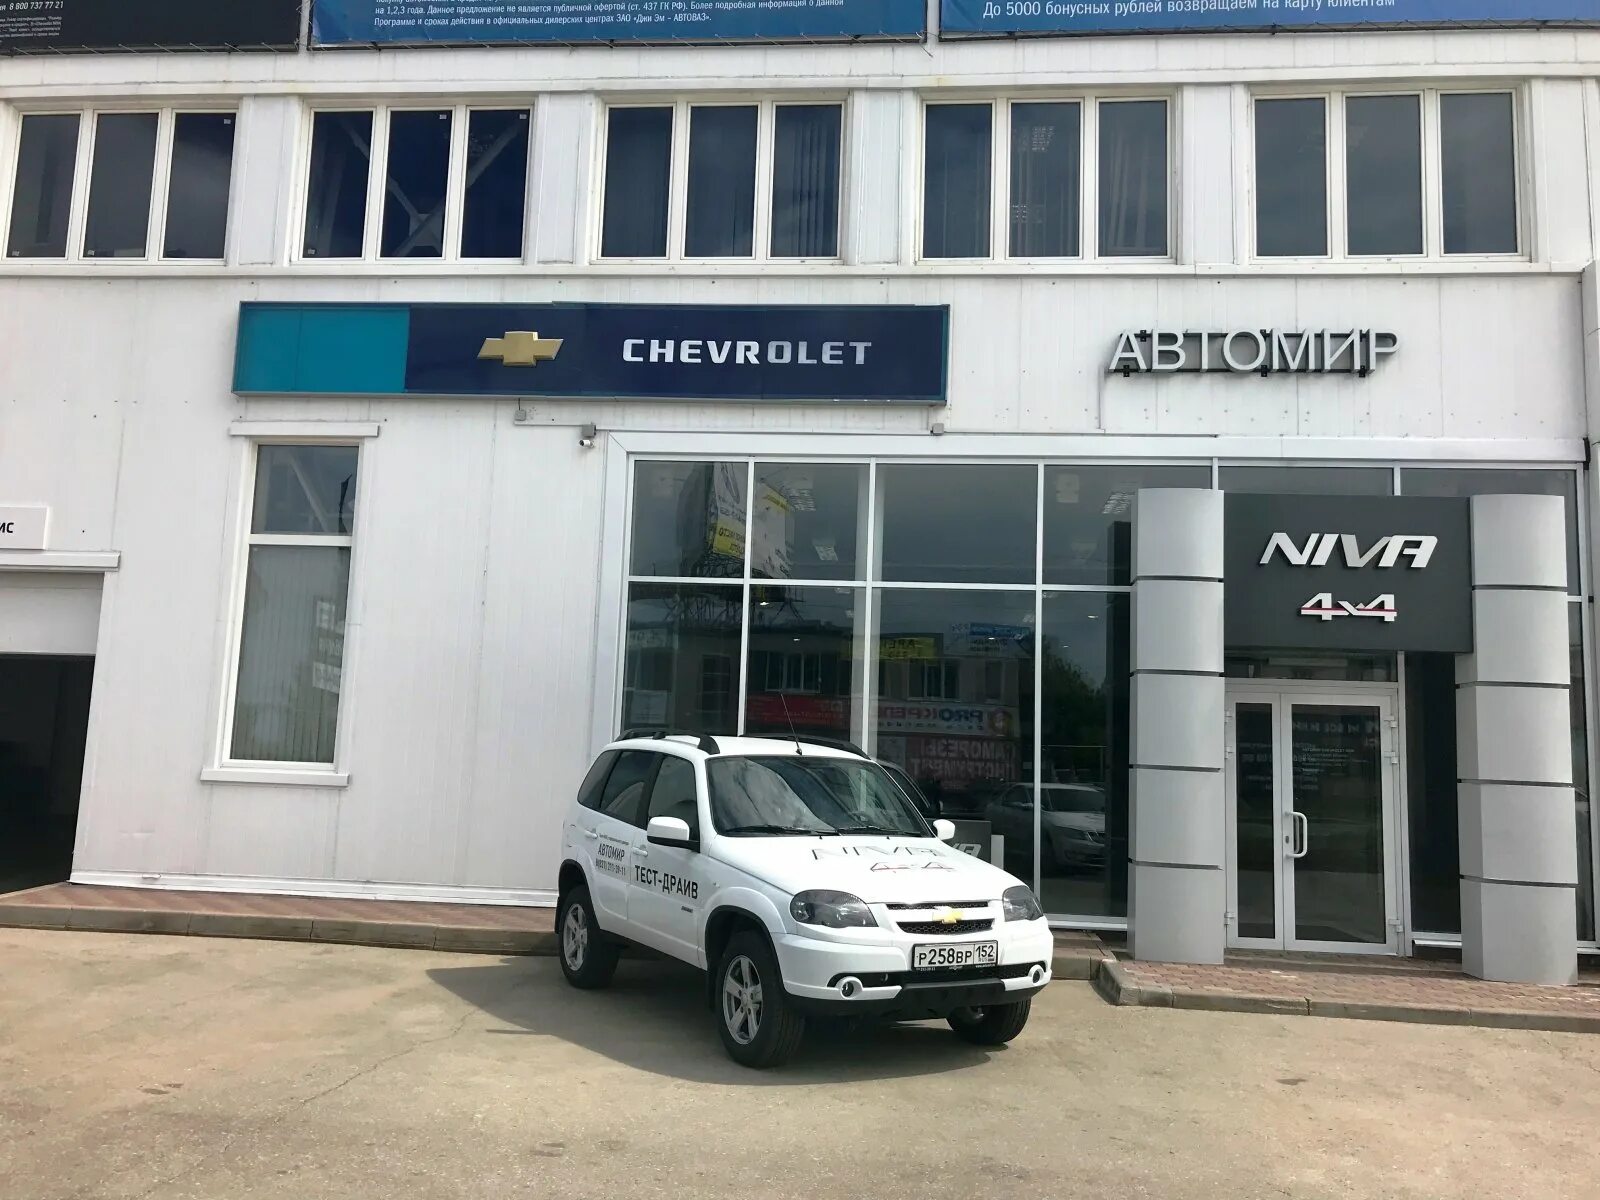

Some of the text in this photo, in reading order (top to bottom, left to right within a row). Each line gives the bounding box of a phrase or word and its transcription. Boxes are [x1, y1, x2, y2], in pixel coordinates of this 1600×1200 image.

[9, 2, 15, 11] 8
[15, 2, 29, 11] 800
[30, 1, 44, 10] 737
[45, 1, 54, 9] 77
[55, 1, 64, 9] 21
[387, 5, 405, 15] 1,2,3
[407, 7, 426, 15] года.
[427, 5, 455, 14] Данное
[456, 5, 505, 14] предложение
[506, 5, 516, 13] не
[517, 5, 551, 13] является
[553, 4, 592, 13] публичной
[593, 2, 626, 13] офертой
[627, 2, 641, 12] (ст.
[643, 2, 657, 11] 437
[660, 2, 670, 10] ГК
[671, 2, 688, 10] РФ).
[690, 1, 713, 10] Более
[715, 1, 756, 10] подробная
[758, 0, 806, 9] информация
[983, 2, 1001, 19] До
[1006, 1, 1041, 16] 5000
[1045, 1, 1110, 18] бонусных
[1114, 0, 1162, 16] рублей
[1167, 0, 1257, 14] возвращаем
[1263, 0, 1279, 9] на
[1284, 0, 1322, 11] карту
[374, 17, 416, 27] Программе
[424, 18, 449, 26] сроках
[450, 16, 484, 26] действия
[492, 15, 543, 25] официальных
[544, 16, 583, 25] дилерских
[584, 15, 614, 23] центрах
[615, 14, 631, 22] ЗАО
[653, 14, 665, 22] Эм
[673, 13, 712, 22] АВТОВАЗ».
[622, 339, 872, 365] CHEVROLET
[1107, 328, 1400, 374] АВТОМИР
[1259, 532, 1438, 569] NIVA
[1300, 592, 1398, 622] 4x4
[598, 843, 625, 862] АВТОМИР
[976, 945, 994, 958] 152
